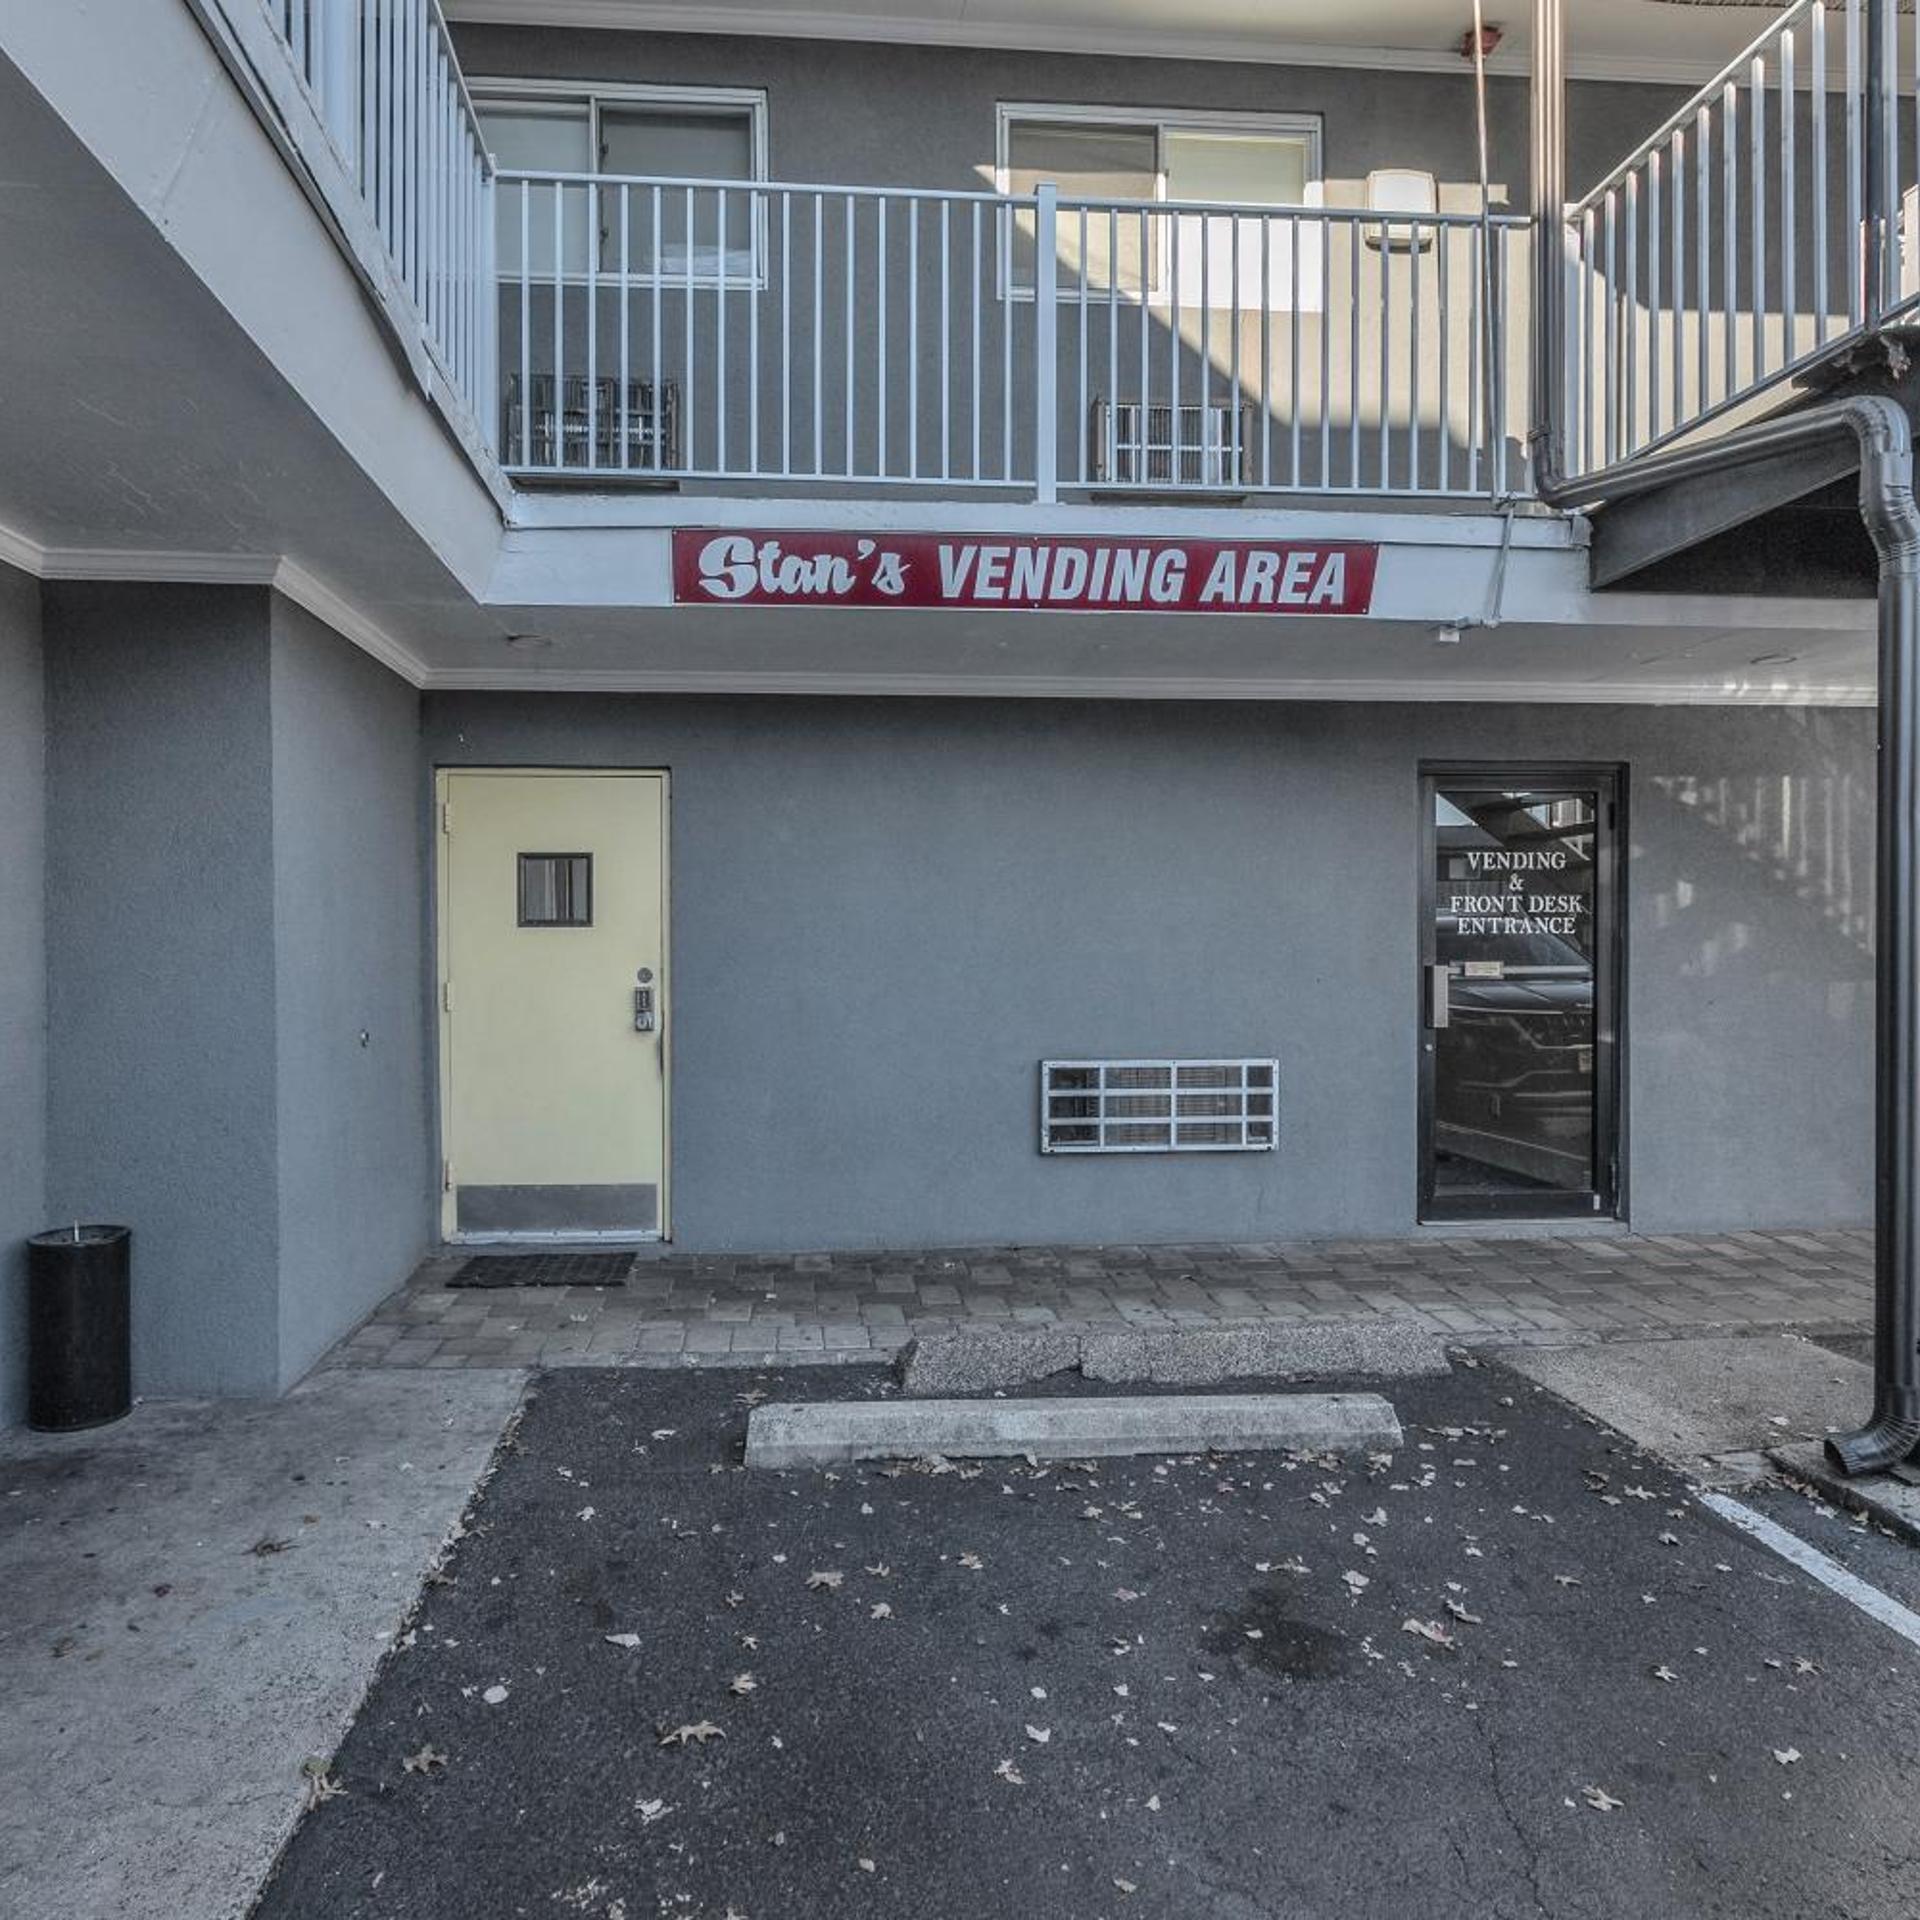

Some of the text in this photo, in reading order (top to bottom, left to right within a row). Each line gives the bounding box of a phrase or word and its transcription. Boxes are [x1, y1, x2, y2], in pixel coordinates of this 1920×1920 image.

[697, 536, 1347, 606] Stan's VENDING AREA
[1467, 852, 1567, 870] VENDING
[1508, 873, 1525, 892] &
[1450, 895, 1583, 914] FRONT DESK
[1457, 916, 1576, 935] ENTRANCE
